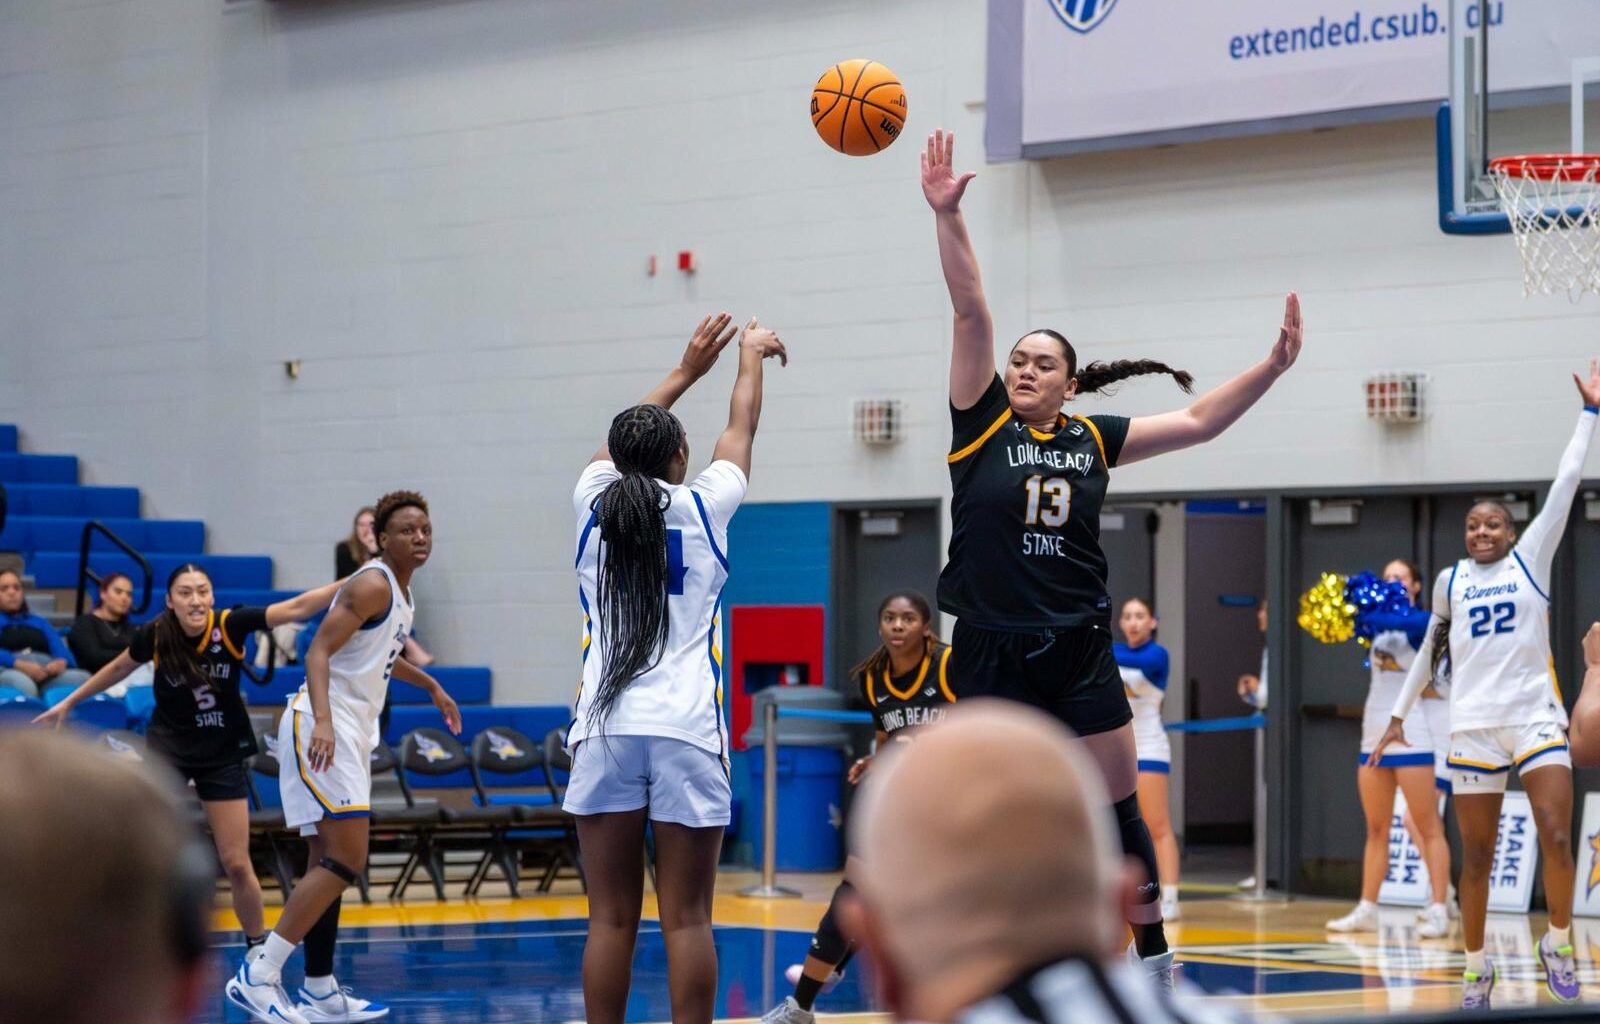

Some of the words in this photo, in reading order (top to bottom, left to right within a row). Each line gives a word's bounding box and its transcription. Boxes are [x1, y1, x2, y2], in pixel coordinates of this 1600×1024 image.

[1229, 1, 1503, 59] extended.csub.du
[1007, 443, 1042, 467] LONG
[1044, 451, 1094, 476] BEACH
[1025, 474, 1071, 527] 13
[1023, 532, 1065, 557] STATE
[1462, 581, 1519, 602] Runners
[1469, 601, 1516, 639] 22
[192, 684, 216, 710] 5
[195, 711, 225, 728] STATE
[881, 709, 905, 732] ONG
[1500, 815, 1527, 888] MAKE
